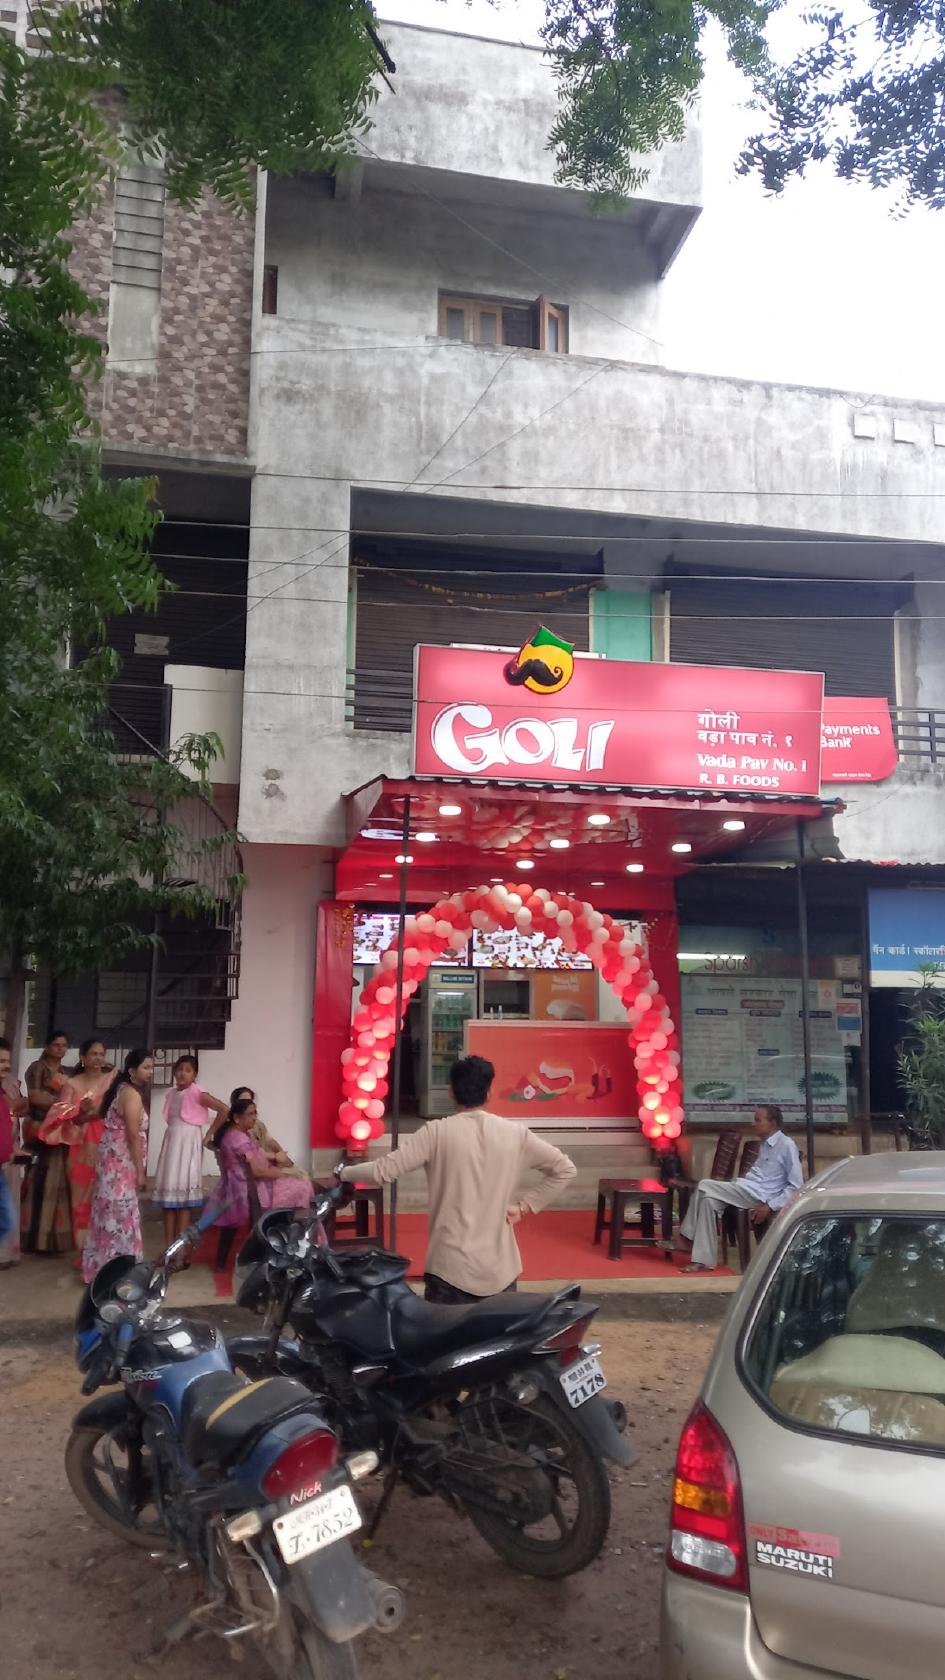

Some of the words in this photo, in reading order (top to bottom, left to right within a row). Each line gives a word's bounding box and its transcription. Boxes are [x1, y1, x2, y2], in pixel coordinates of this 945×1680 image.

[697, 709, 740, 729] गोली
[431, 701, 615, 773] GOLI
[697, 730, 727, 747] वड़ा
[729, 731, 759, 746] पाव
[697, 753, 736, 769] Vada
[741, 755, 769, 770] Pav
[700, 773, 712, 785] R.
[716, 773, 729, 785] B.
[733, 774, 780, 788] FOODS
[570, 1373, 605, 1405] 7178
[290, 1481, 322, 1505] Nick
[757, 1541, 833, 1568] MARUTI
[757, 1552, 833, 1578] SUZUKI
